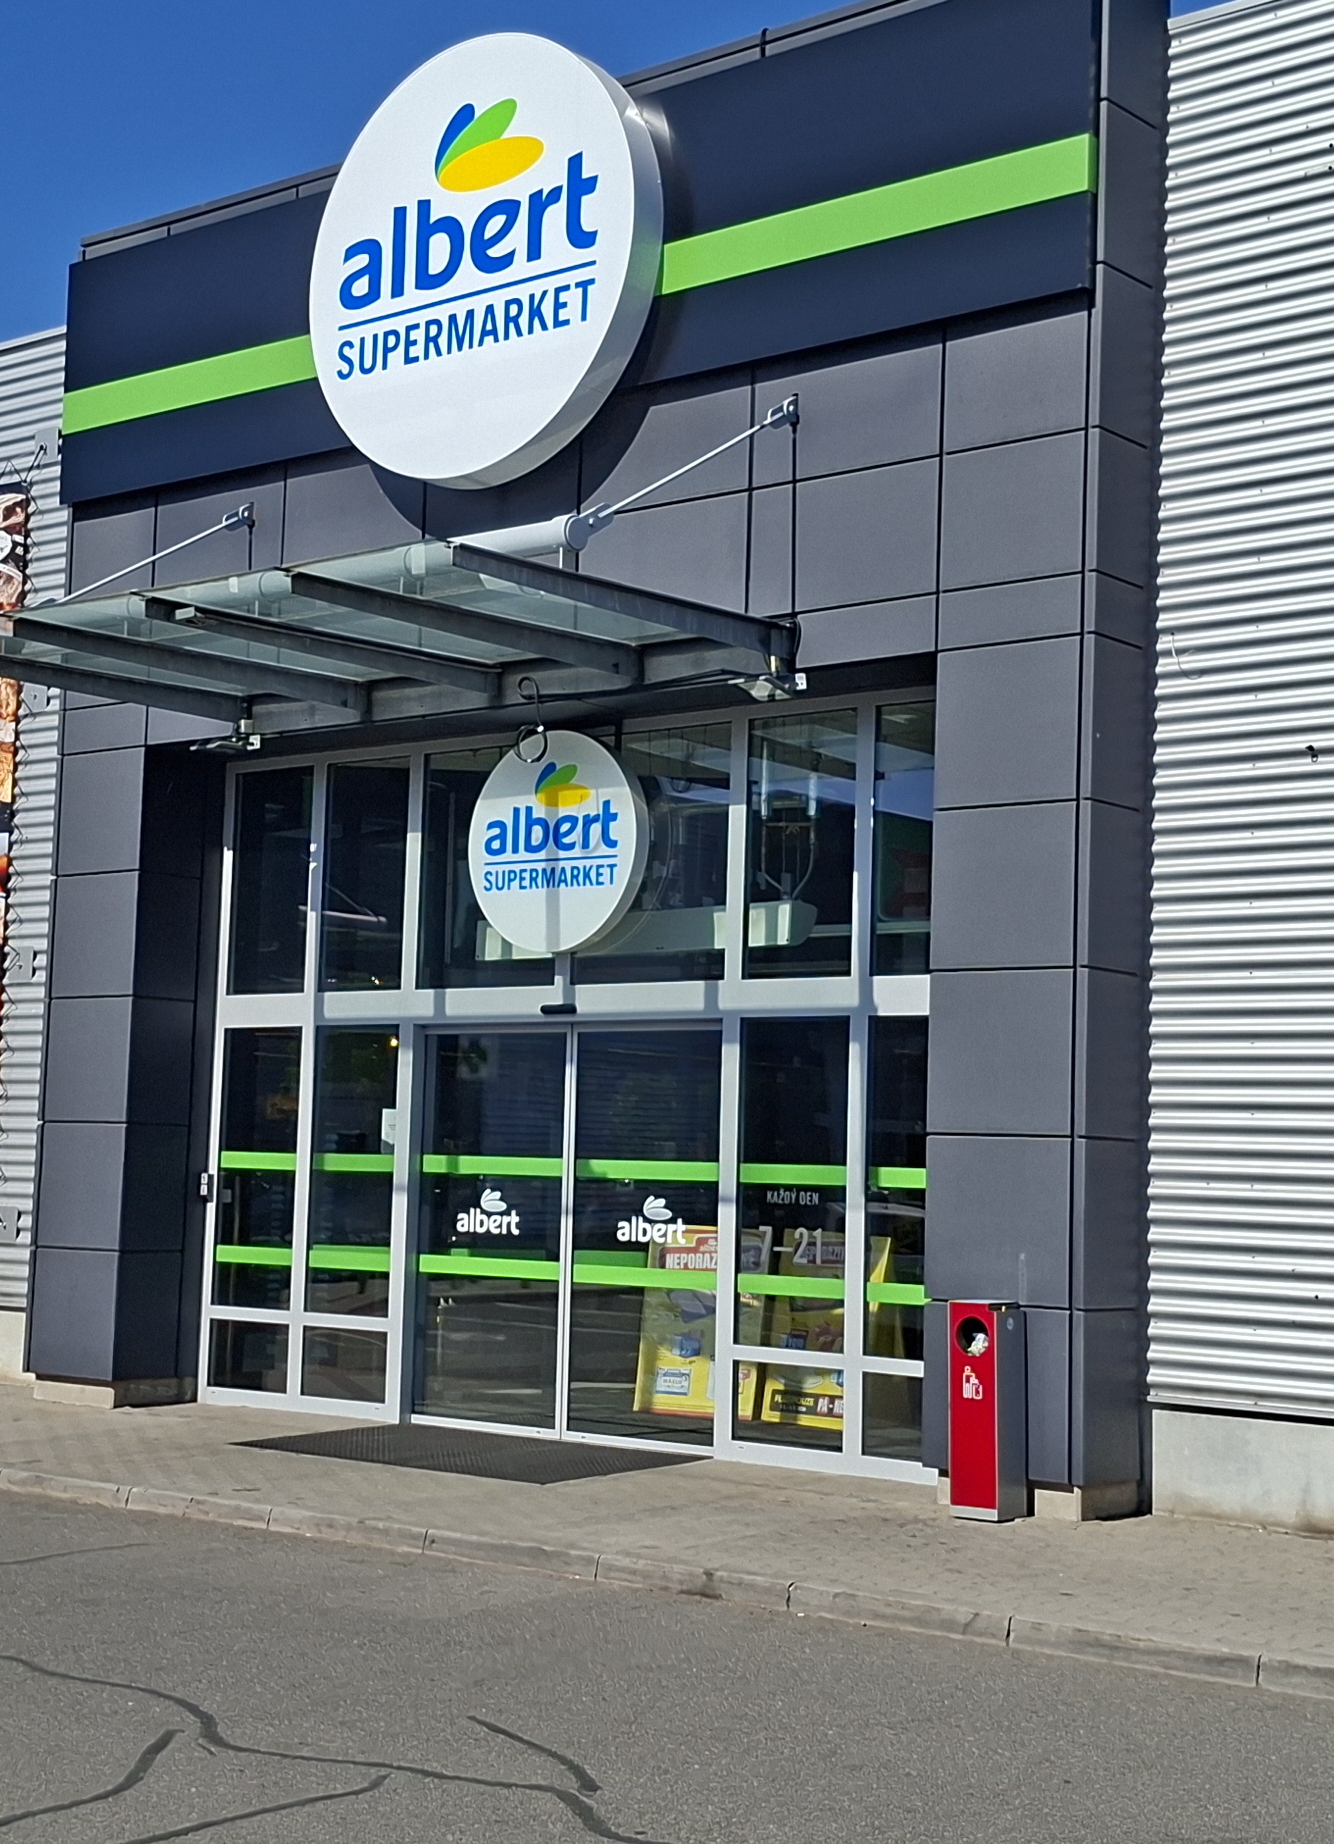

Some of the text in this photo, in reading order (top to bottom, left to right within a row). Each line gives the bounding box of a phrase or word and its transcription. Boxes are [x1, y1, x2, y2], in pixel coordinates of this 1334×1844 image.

[339, 150, 599, 311] albert
[336, 277, 597, 381] SUPERMARKET
[484, 799, 619, 857] albert
[483, 863, 617, 892] SUPERMARKET
[767, 1188, 819, 1205] KAŽDÝ DEN
[456, 1207, 520, 1236] albert
[617, 1216, 686, 1244] albert
